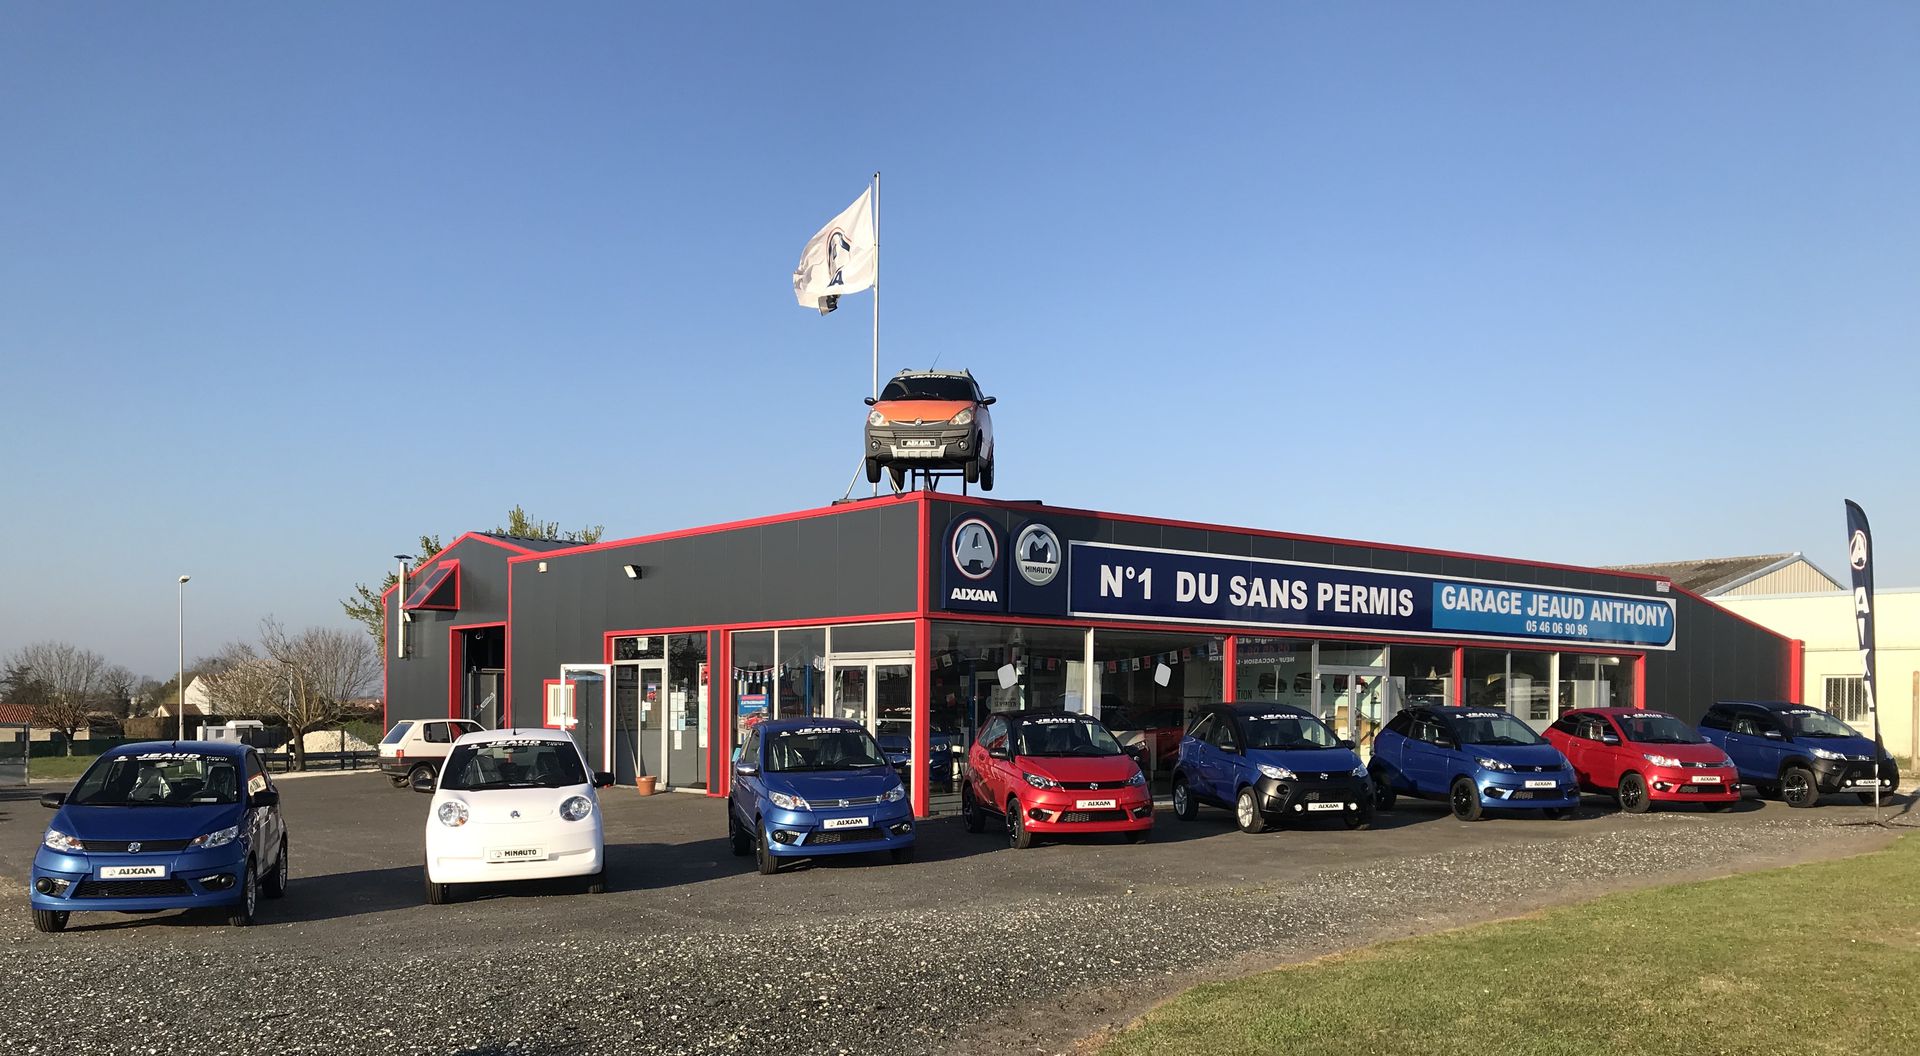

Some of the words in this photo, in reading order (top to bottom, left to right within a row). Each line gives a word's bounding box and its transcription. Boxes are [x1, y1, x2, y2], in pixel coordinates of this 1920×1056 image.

[1025, 565, 1052, 574] MINAUTO
[950, 587, 998, 603] AIXAM
[1100, 564, 1152, 600] N°1
[1176, 571, 1219, 605] DU
[1229, 575, 1308, 610] SANS
[1317, 582, 1414, 617] PERMIS
[1441, 586, 1522, 615] GARAGE
[1527, 594, 1585, 620] JEAUD
[1590, 600, 1668, 627] ANTHONY
[1526, 620, 1537, 632] 05
[1539, 621, 1550, 633] 46
[1552, 622, 1563, 634] 06
[1565, 623, 1576, 635] 90
[1577, 624, 1588, 636] 96
[836, 818, 863, 826] AIXAM
[504, 849, 537, 857] MINAUTO
[118, 867, 157, 875] AIXAM
